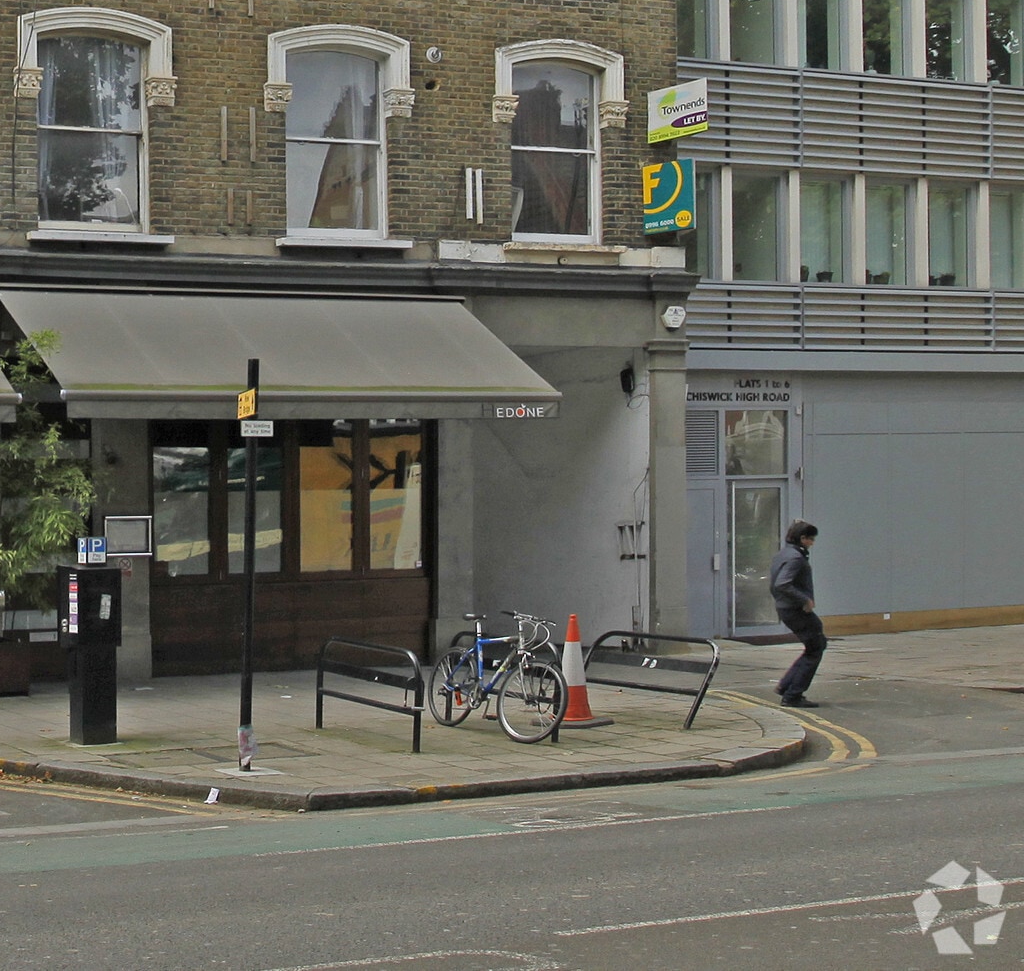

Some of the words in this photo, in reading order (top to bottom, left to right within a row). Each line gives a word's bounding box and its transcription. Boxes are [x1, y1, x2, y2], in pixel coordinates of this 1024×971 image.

[662, 97, 705, 116] Townends
[684, 116, 696, 125] LET
[643, 163, 663, 204] F
[686, 392, 733, 402] CHISWICK
[735, 392, 760, 402] HIGH
[762, 393, 790, 402] ROAD
[79, 539, 85, 552] P
[92, 539, 102, 552] P
